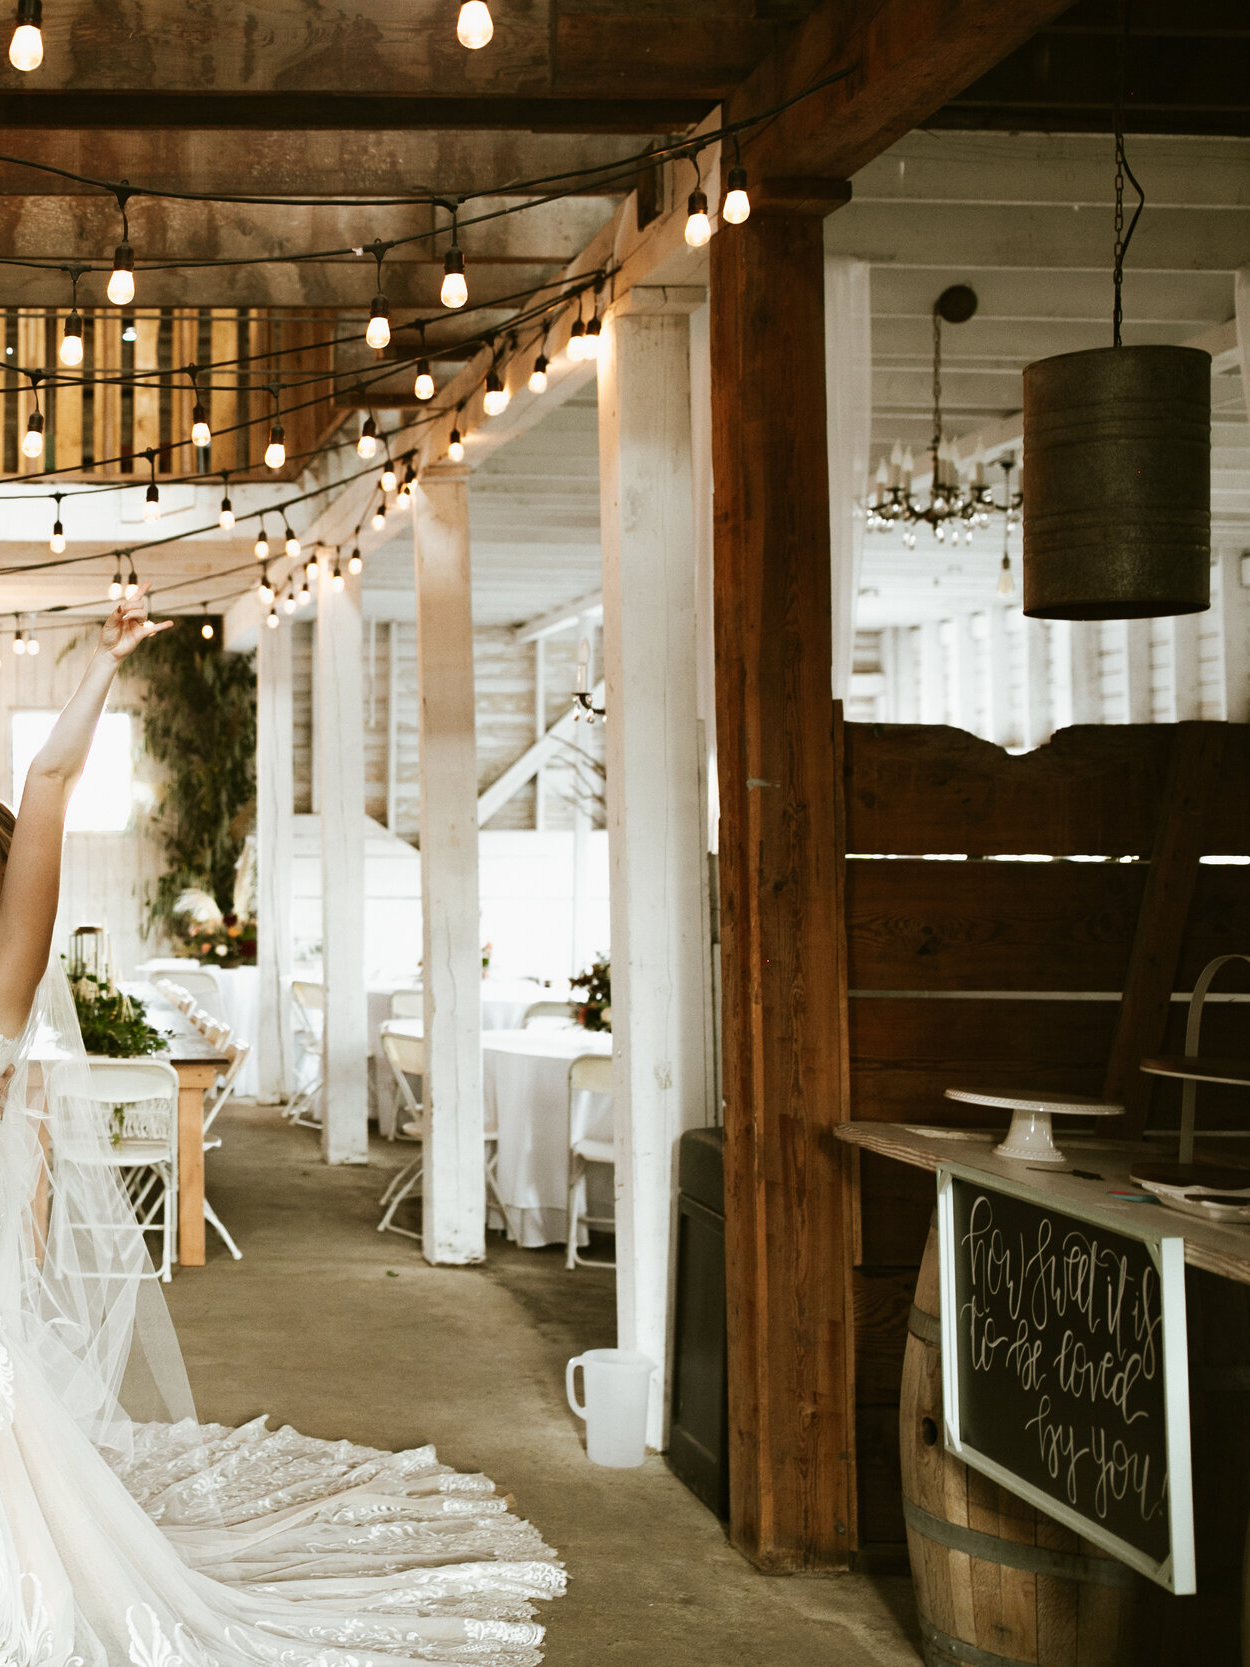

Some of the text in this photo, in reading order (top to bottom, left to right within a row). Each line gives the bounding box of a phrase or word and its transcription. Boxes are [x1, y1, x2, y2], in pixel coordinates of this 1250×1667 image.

[961, 1195, 1163, 1380] how sweet it is
[959, 1294, 1150, 1425] to be loved
[1024, 1394, 1090, 1505] by
